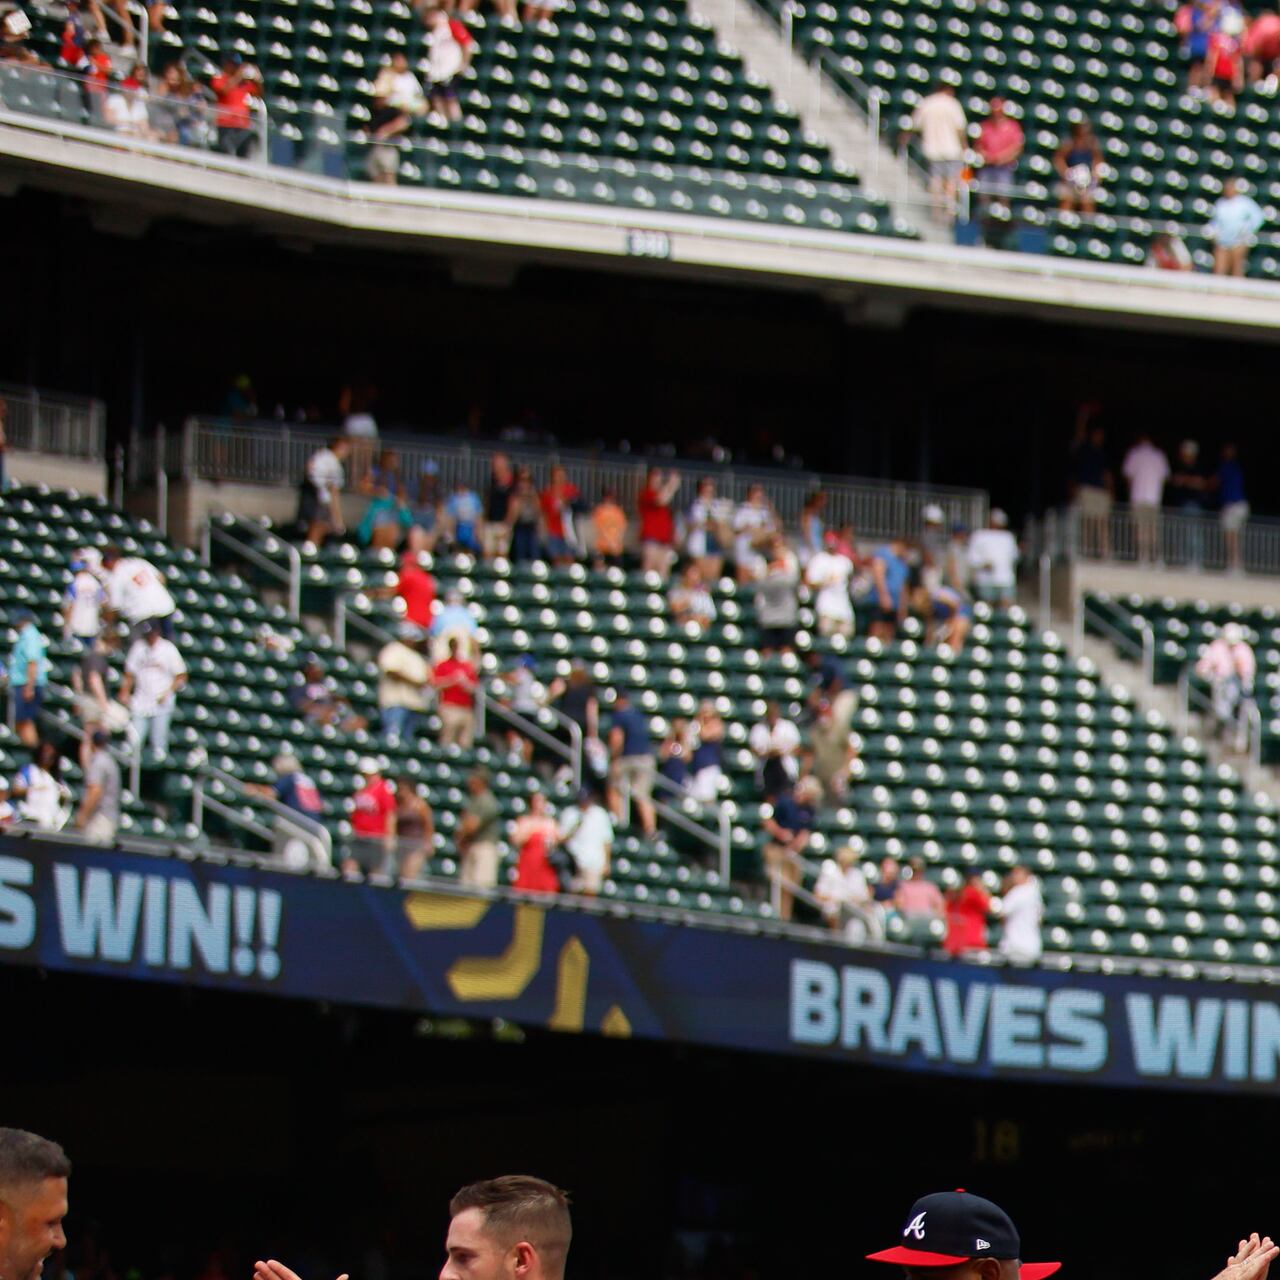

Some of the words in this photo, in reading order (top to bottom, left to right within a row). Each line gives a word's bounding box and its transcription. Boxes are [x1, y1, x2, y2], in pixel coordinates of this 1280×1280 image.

[53, 861, 282, 980] WIN!!
[789, 958, 1110, 1073] BRAVES
[903, 1211, 928, 1240] A
